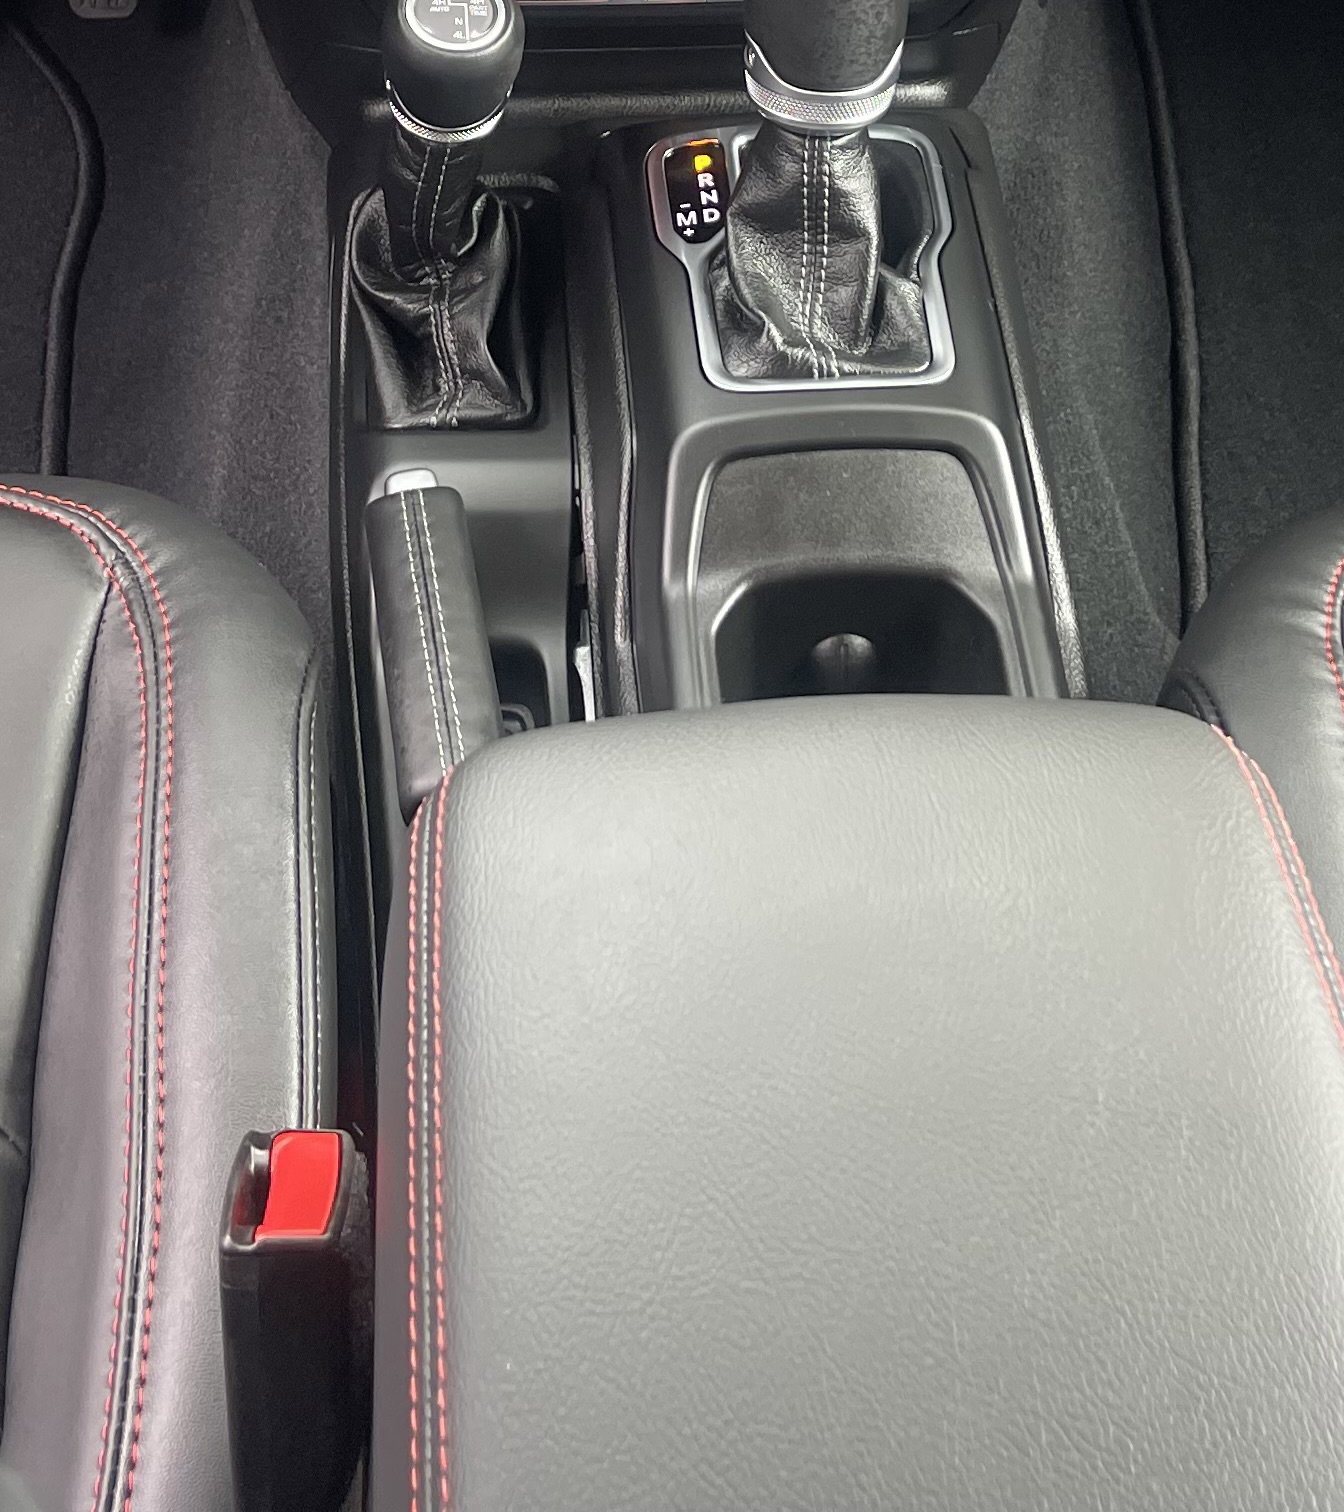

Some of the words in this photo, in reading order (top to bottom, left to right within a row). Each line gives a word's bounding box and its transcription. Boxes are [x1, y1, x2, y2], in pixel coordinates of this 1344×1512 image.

[455, 17, 464, 25] N
[694, 154, 712, 172] P
[697, 172, 714, 187] R
[700, 189, 718, 205] N
[676, 210, 697, 226] M
[703, 208, 720, 223] D
